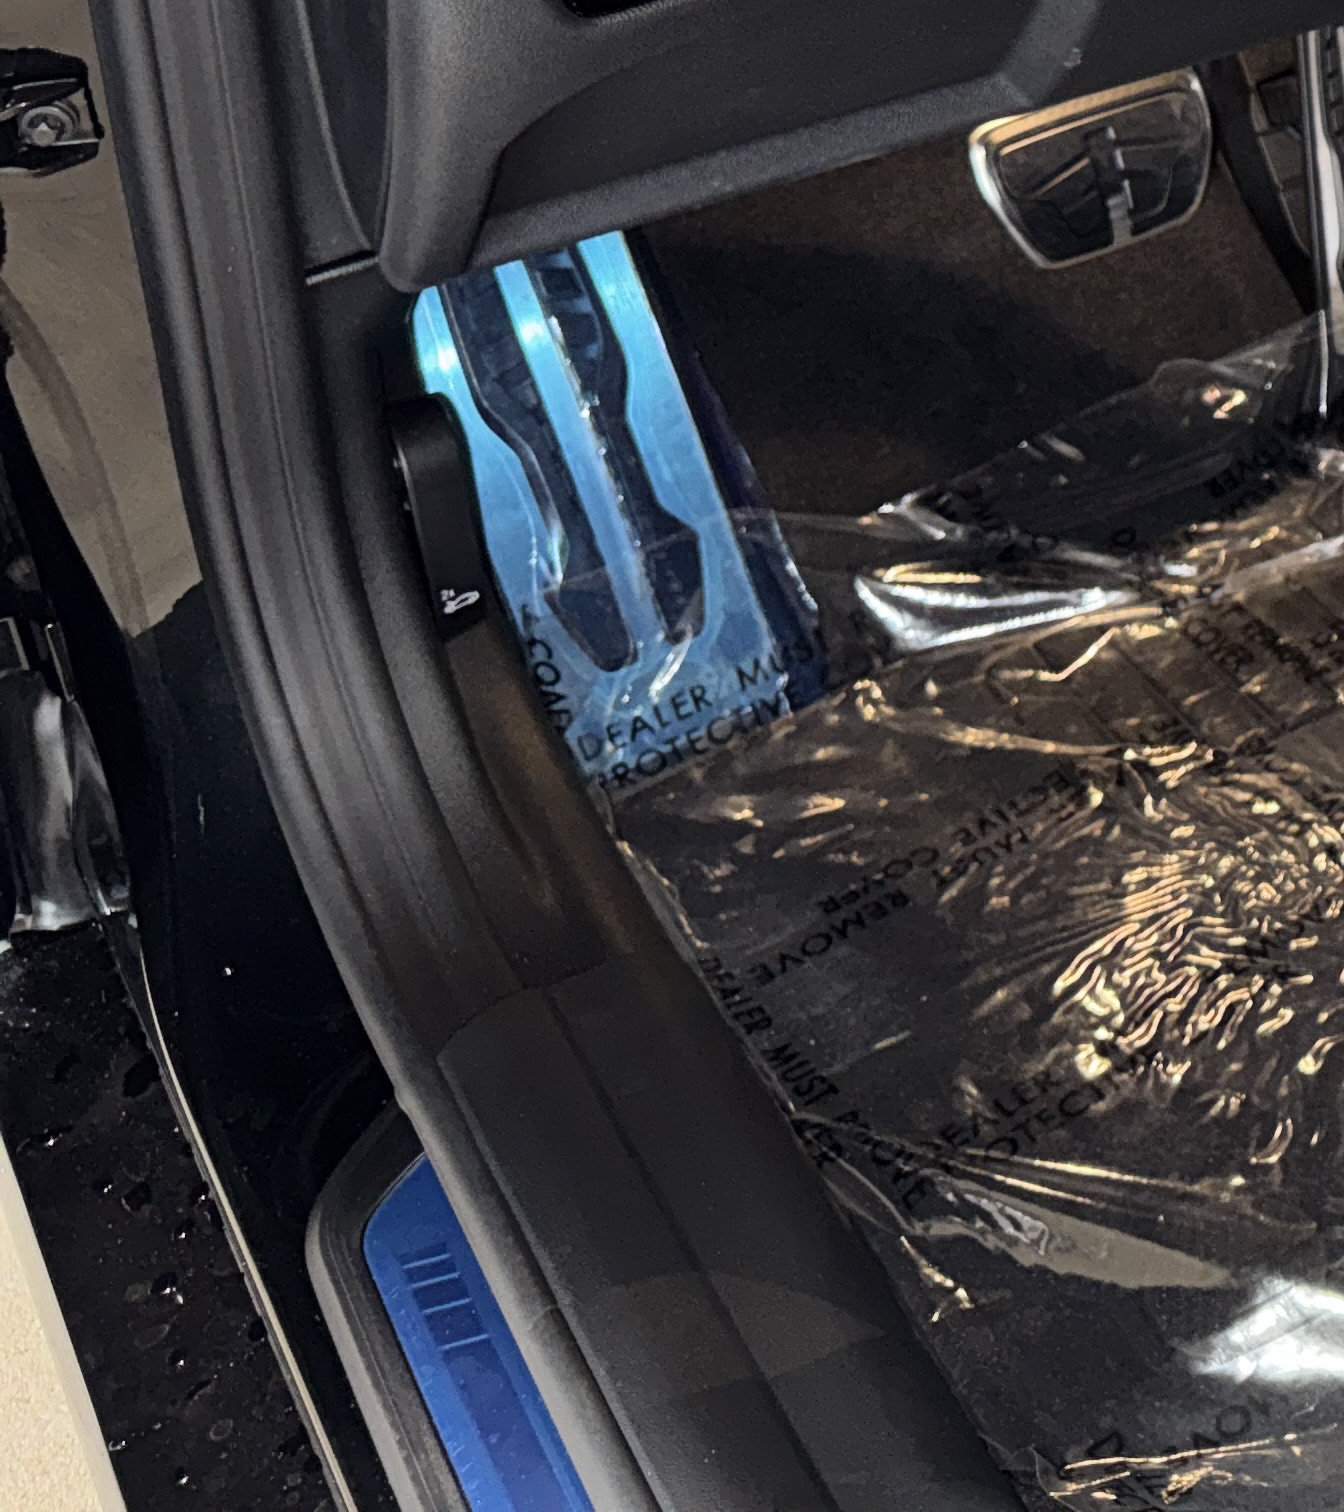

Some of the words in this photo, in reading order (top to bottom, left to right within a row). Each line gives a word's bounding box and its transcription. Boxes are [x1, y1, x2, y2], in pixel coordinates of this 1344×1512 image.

[578, 683, 713, 762] DEALER
[748, 887, 912, 986] REMOVE
[698, 954, 774, 1035] DEALER
[761, 1041, 840, 1106] MUST
